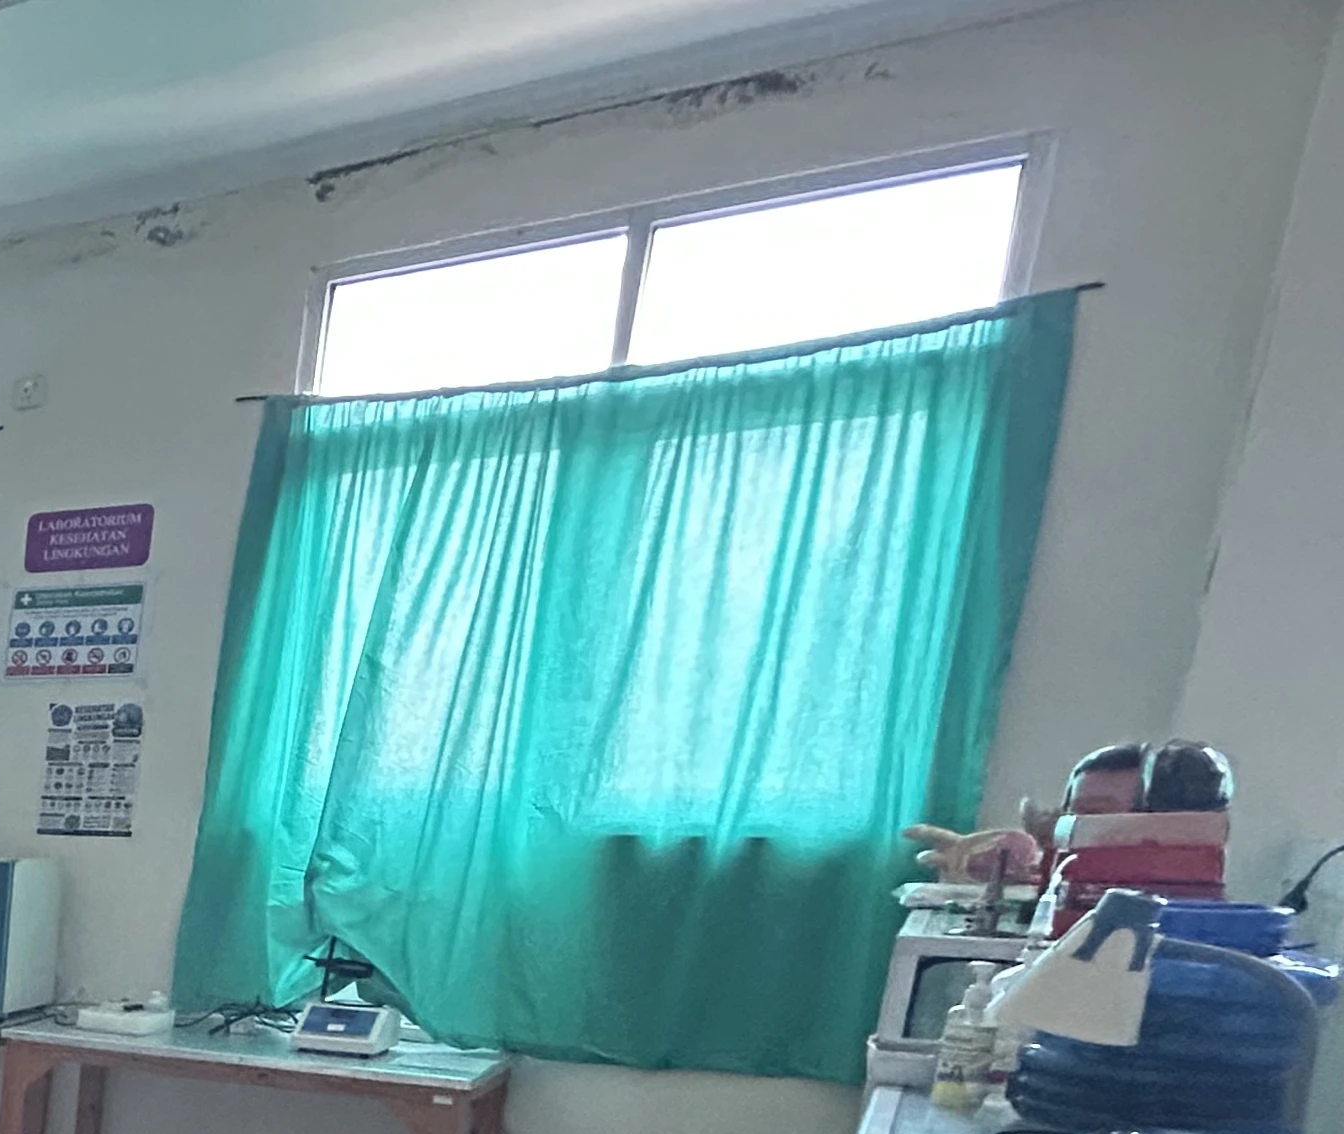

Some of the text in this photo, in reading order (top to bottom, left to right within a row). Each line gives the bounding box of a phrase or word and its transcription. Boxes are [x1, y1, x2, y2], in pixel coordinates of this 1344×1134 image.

[38, 512, 143, 533] LABORATORIUM
[49, 529, 128, 546] KESEHATAN
[43, 542, 130, 561] LINGKUNGAN
